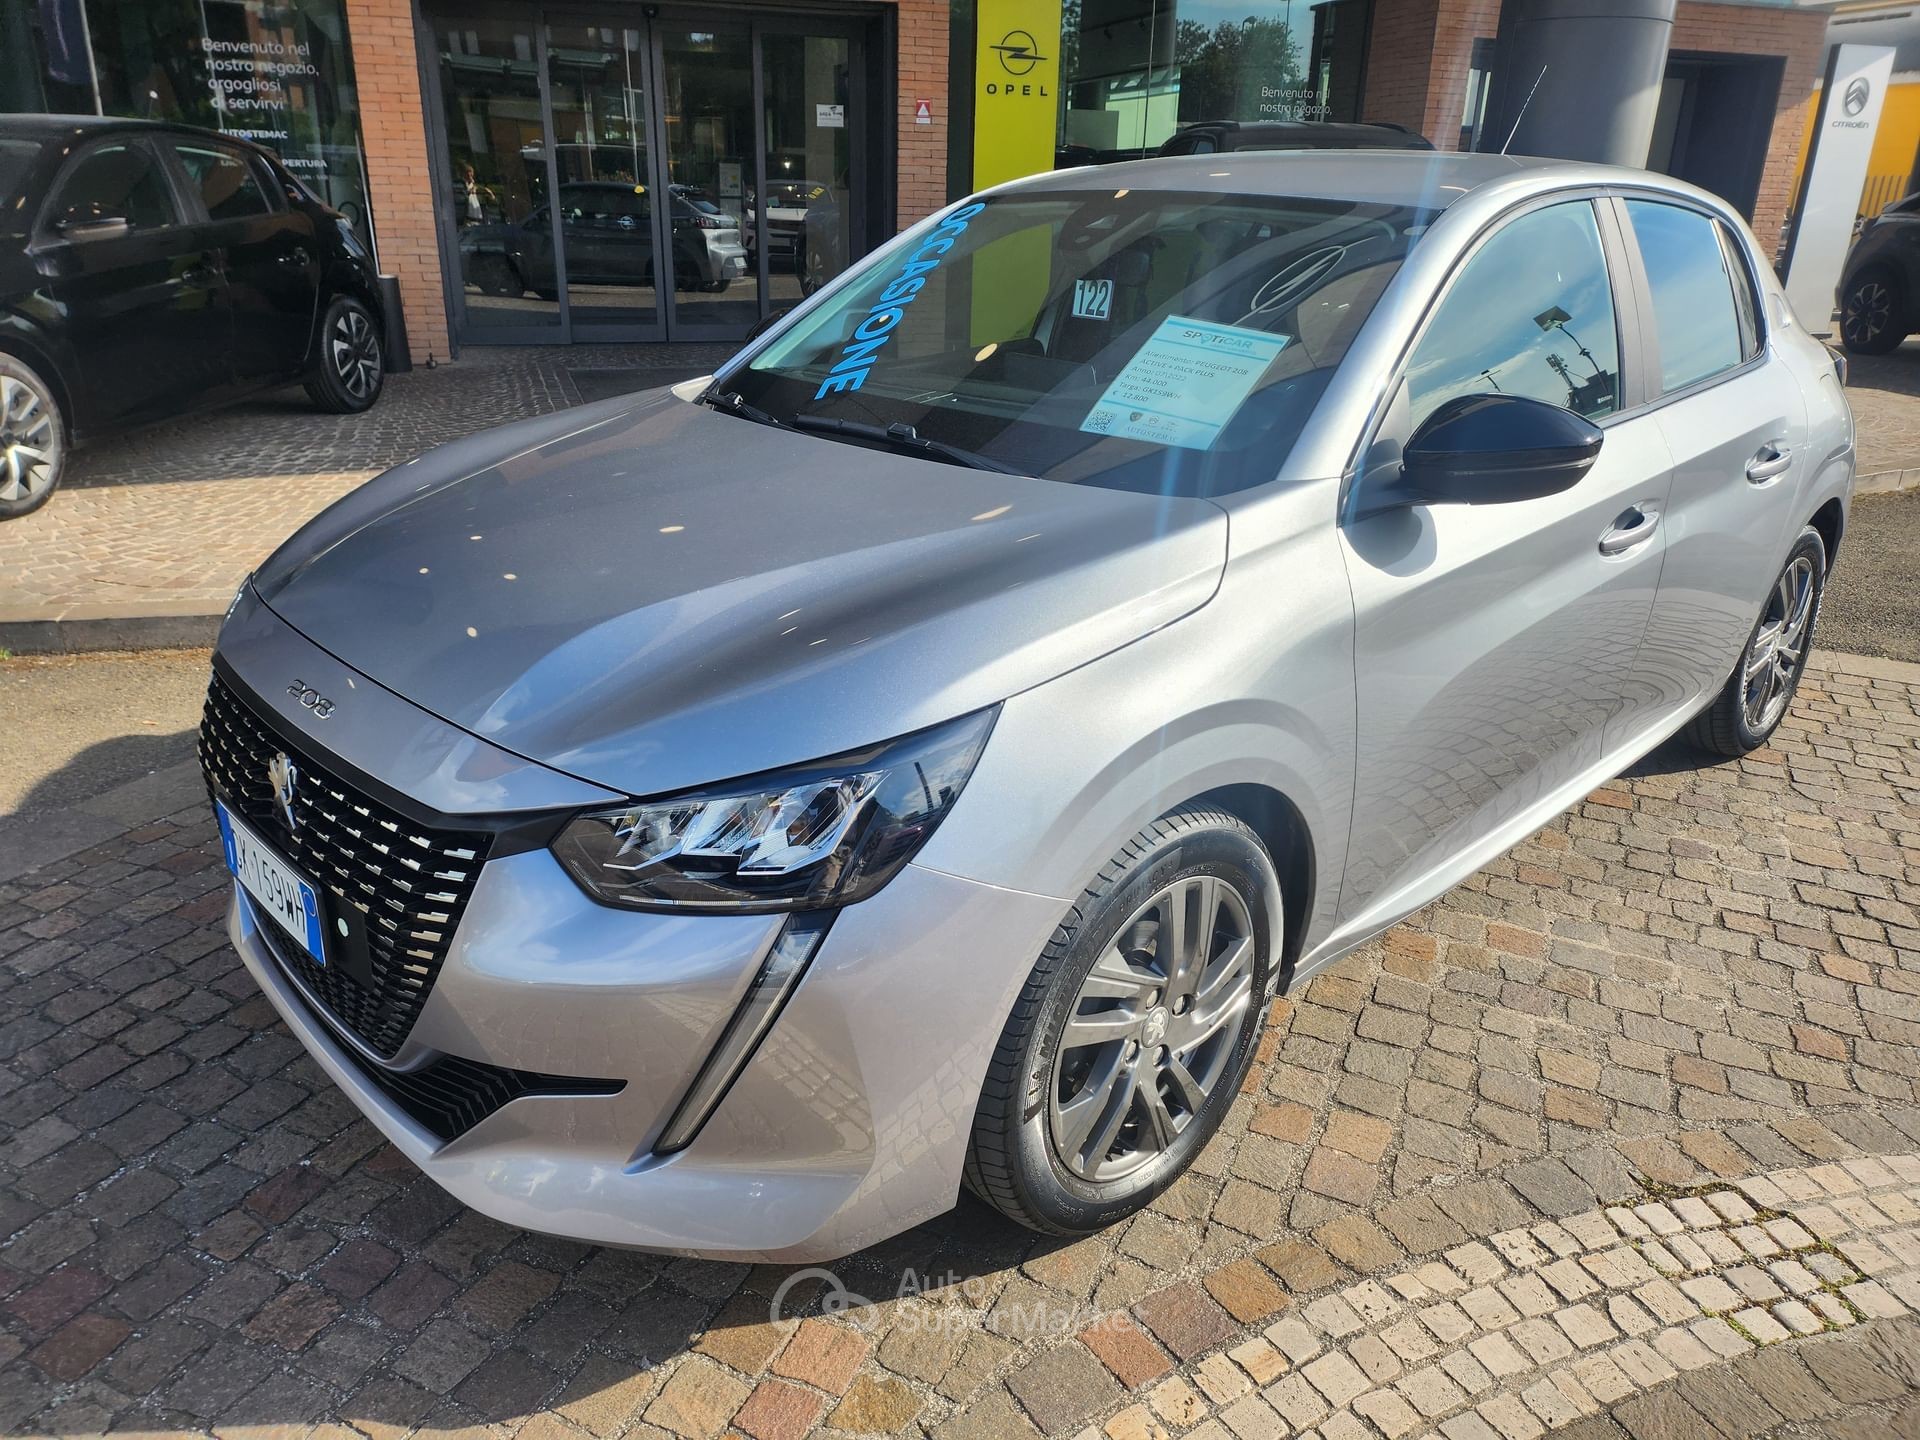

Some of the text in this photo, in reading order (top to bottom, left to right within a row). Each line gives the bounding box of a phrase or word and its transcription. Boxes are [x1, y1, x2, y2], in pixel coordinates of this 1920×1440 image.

[202, 37, 310, 56] Benvenuto nel
[205, 59, 319, 77] nostro negozio,
[208, 77, 281, 94] orgogliosi
[986, 83, 1048, 97] OPEL
[1261, 86, 1331, 99] Benvenuto nl
[229, 96, 284, 110] servirvi
[1260, 103, 1291, 113] nostro
[814, 202, 986, 401] OCCASIONE
[1079, 280, 1109, 317] 122
[286, 679, 336, 720] 208
